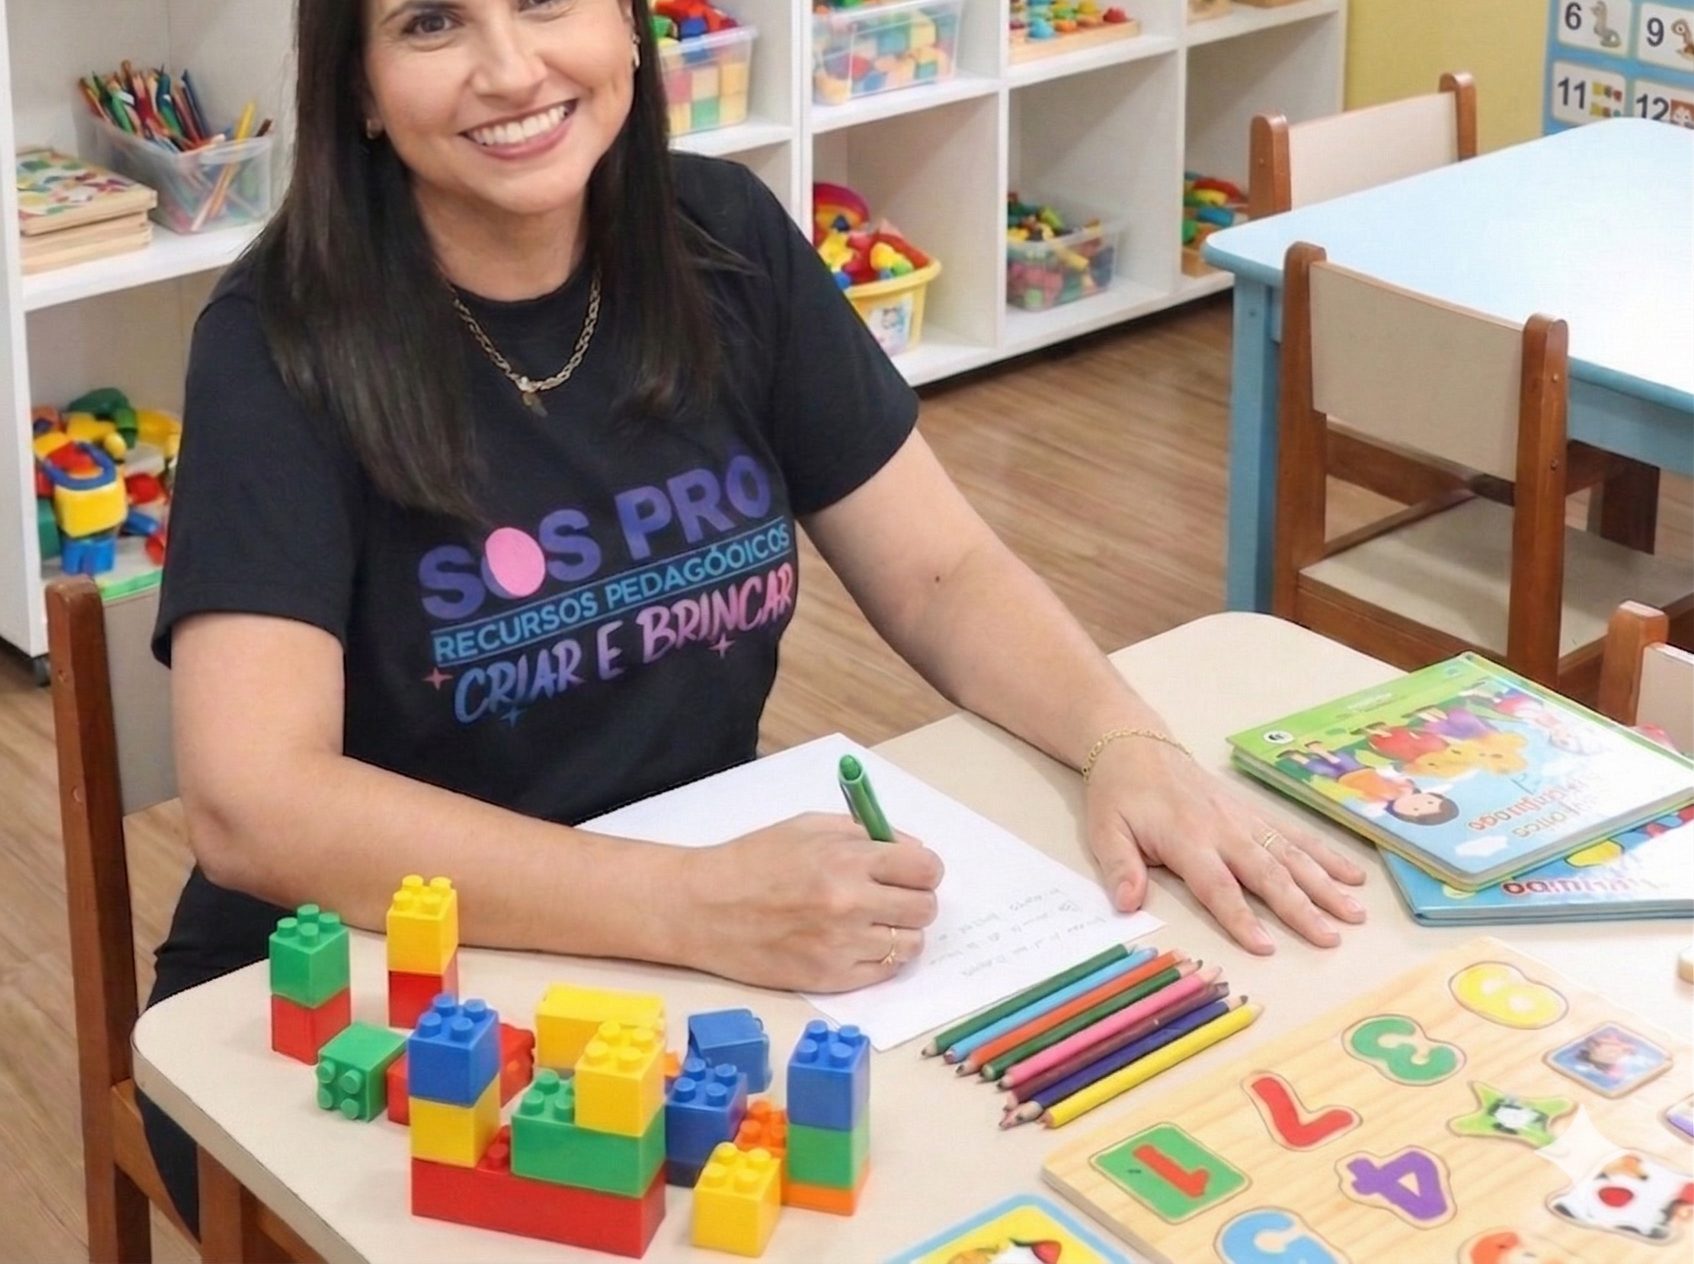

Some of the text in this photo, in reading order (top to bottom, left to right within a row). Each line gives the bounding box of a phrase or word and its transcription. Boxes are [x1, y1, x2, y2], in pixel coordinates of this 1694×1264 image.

[1565, 2, 1665, 46] 6 9
[1557, 78, 1669, 120] 11 12
[614, 454, 771, 560] PRO
[434, 590, 598, 664] RECURSOS
[454, 562, 793, 724] CRIAR E BRINCAR
